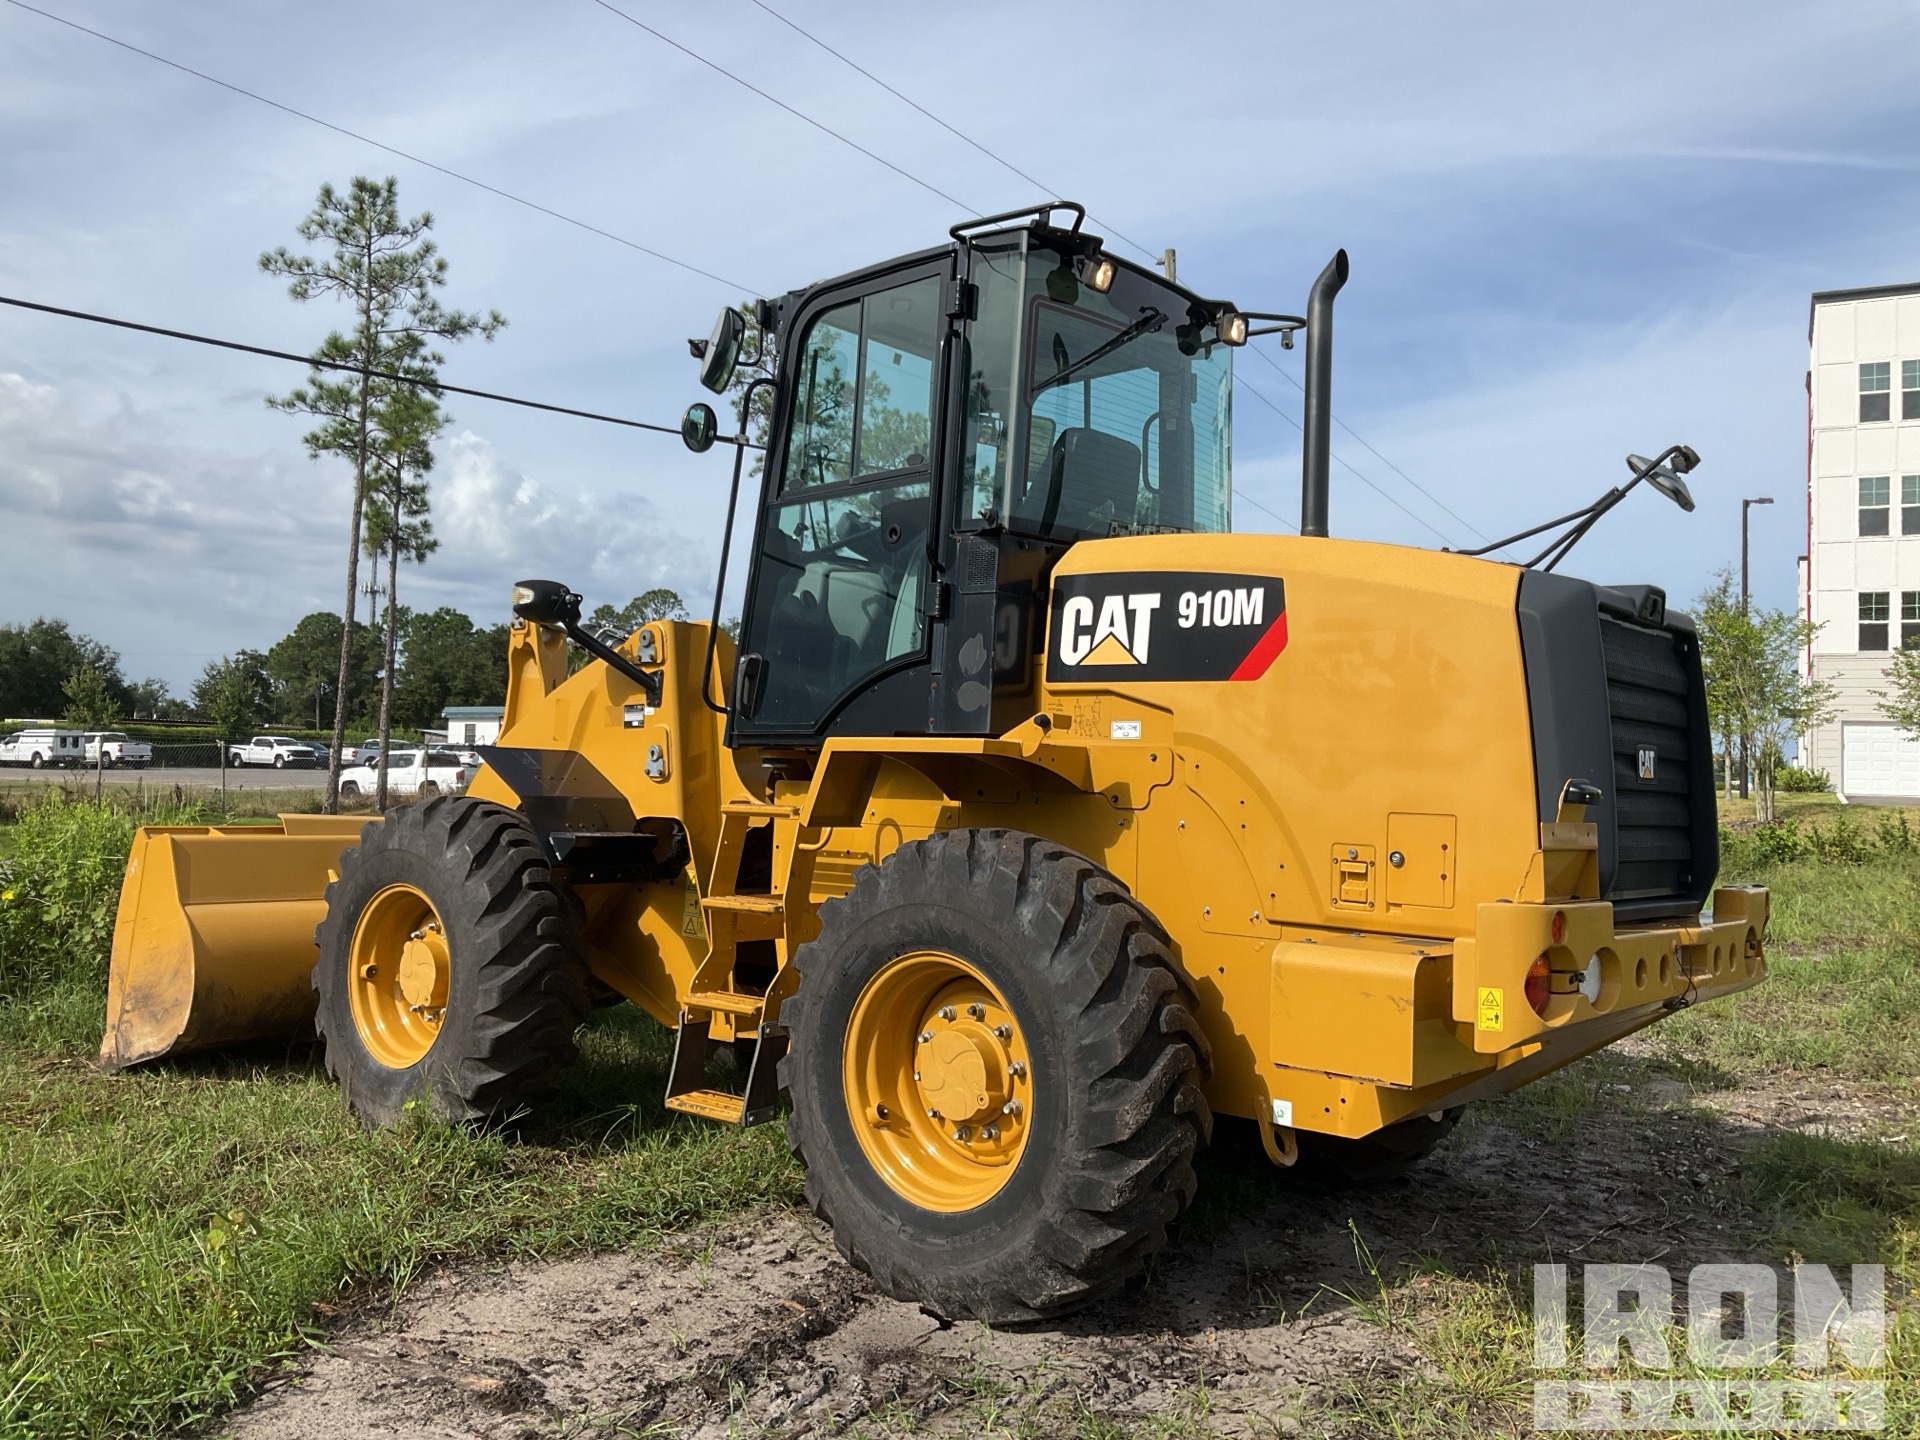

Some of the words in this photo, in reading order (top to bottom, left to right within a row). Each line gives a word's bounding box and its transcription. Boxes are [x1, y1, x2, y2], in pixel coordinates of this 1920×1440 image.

[1060, 593, 1161, 666] CAT
[1178, 587, 1265, 629] 910M
[1639, 749, 1655, 778] CAT
